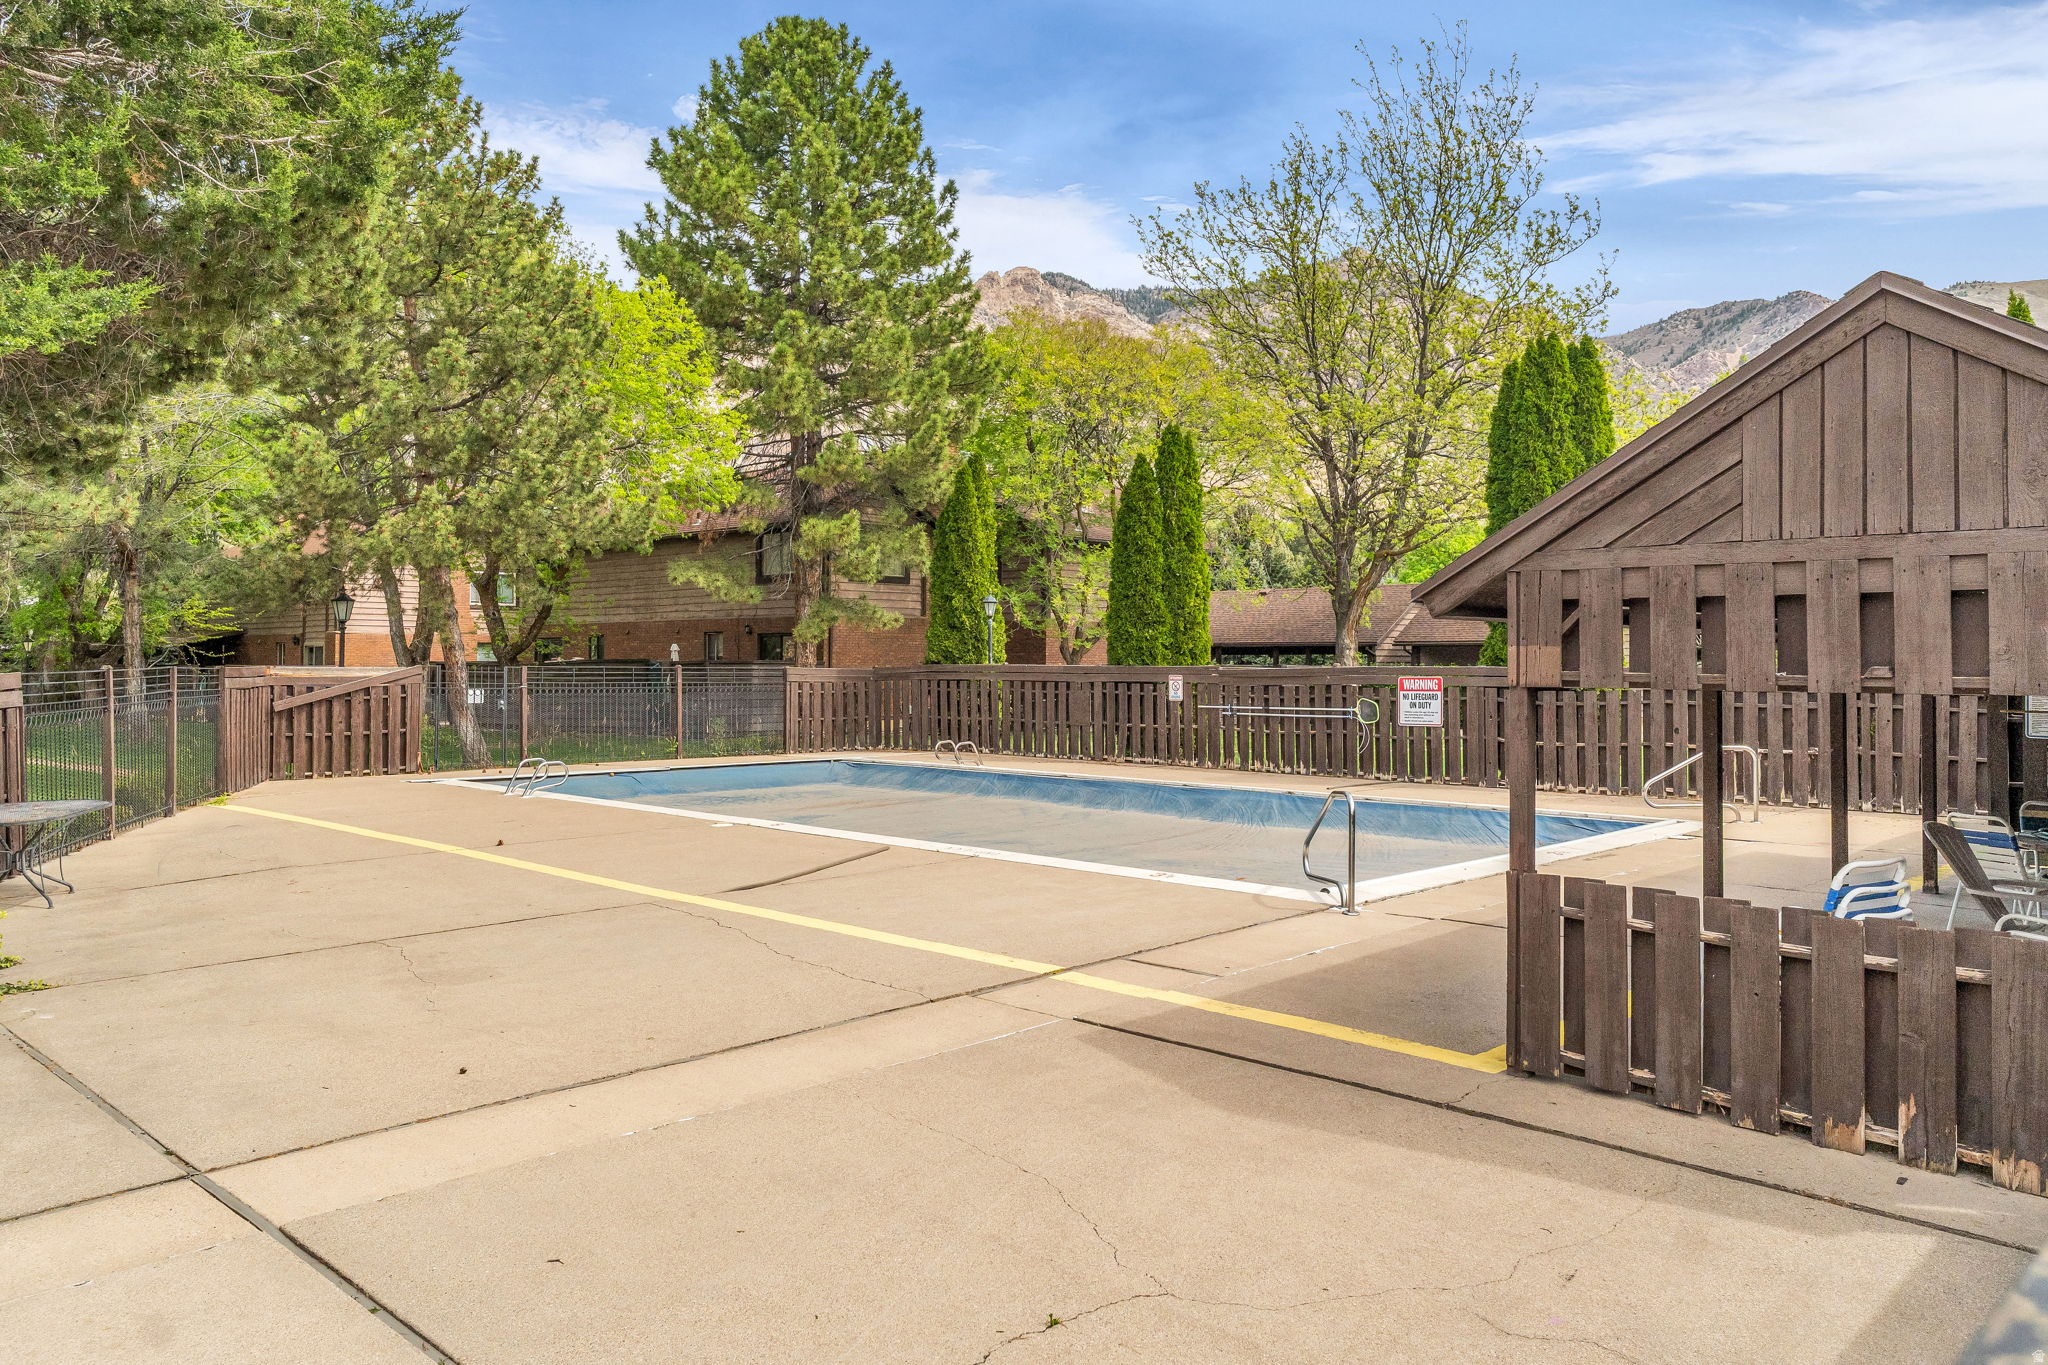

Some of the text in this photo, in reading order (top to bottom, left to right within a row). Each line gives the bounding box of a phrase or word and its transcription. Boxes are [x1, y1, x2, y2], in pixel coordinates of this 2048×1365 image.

[1403, 679, 1438, 690] WARNING
[1410, 693, 1438, 701] LIFEGUARD
[1409, 701, 1431, 709] ON DUTY
